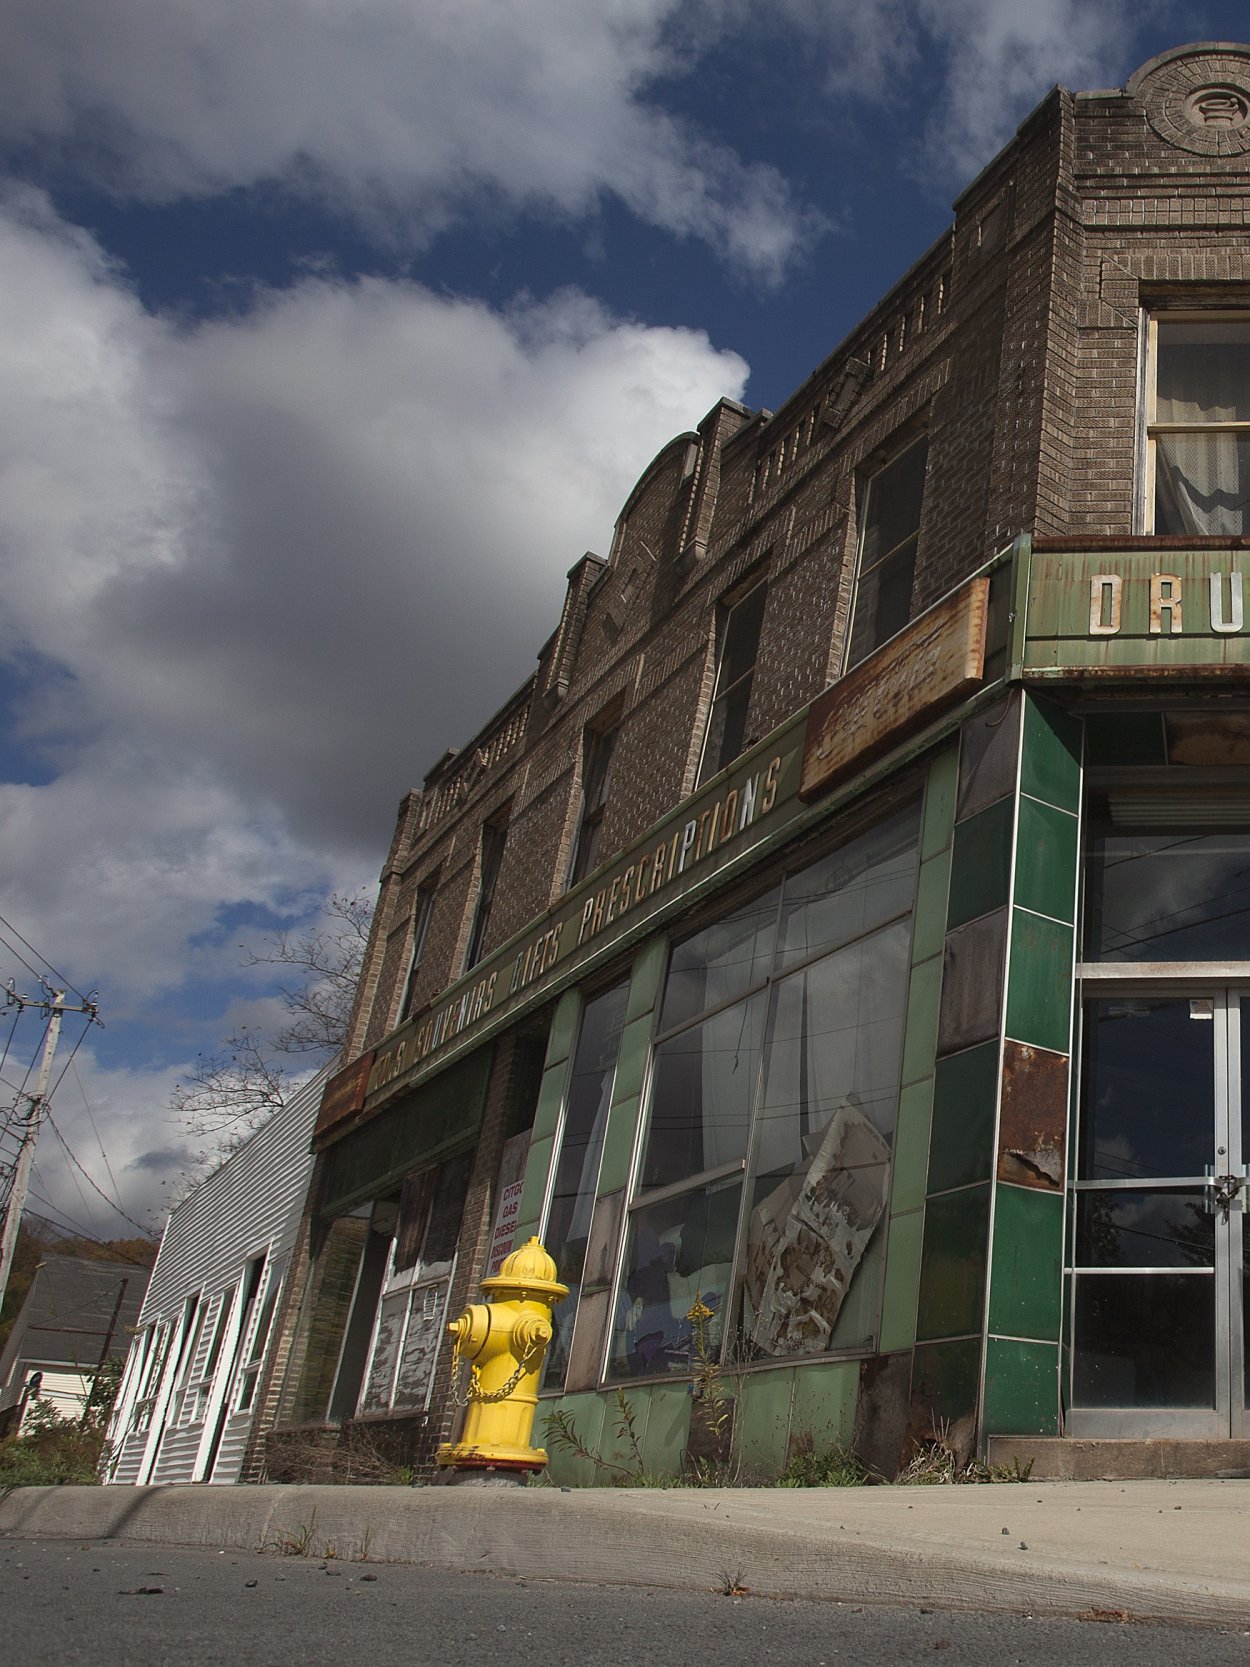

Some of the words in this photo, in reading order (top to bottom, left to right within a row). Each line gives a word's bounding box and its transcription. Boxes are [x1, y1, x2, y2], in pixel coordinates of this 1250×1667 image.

[413, 971, 498, 1064] SOUVENIRS
[509, 922, 563, 994] GIFTS
[577, 756, 781, 946] PRESCRIPTIONS
[502, 1201, 518, 1219] GAS
